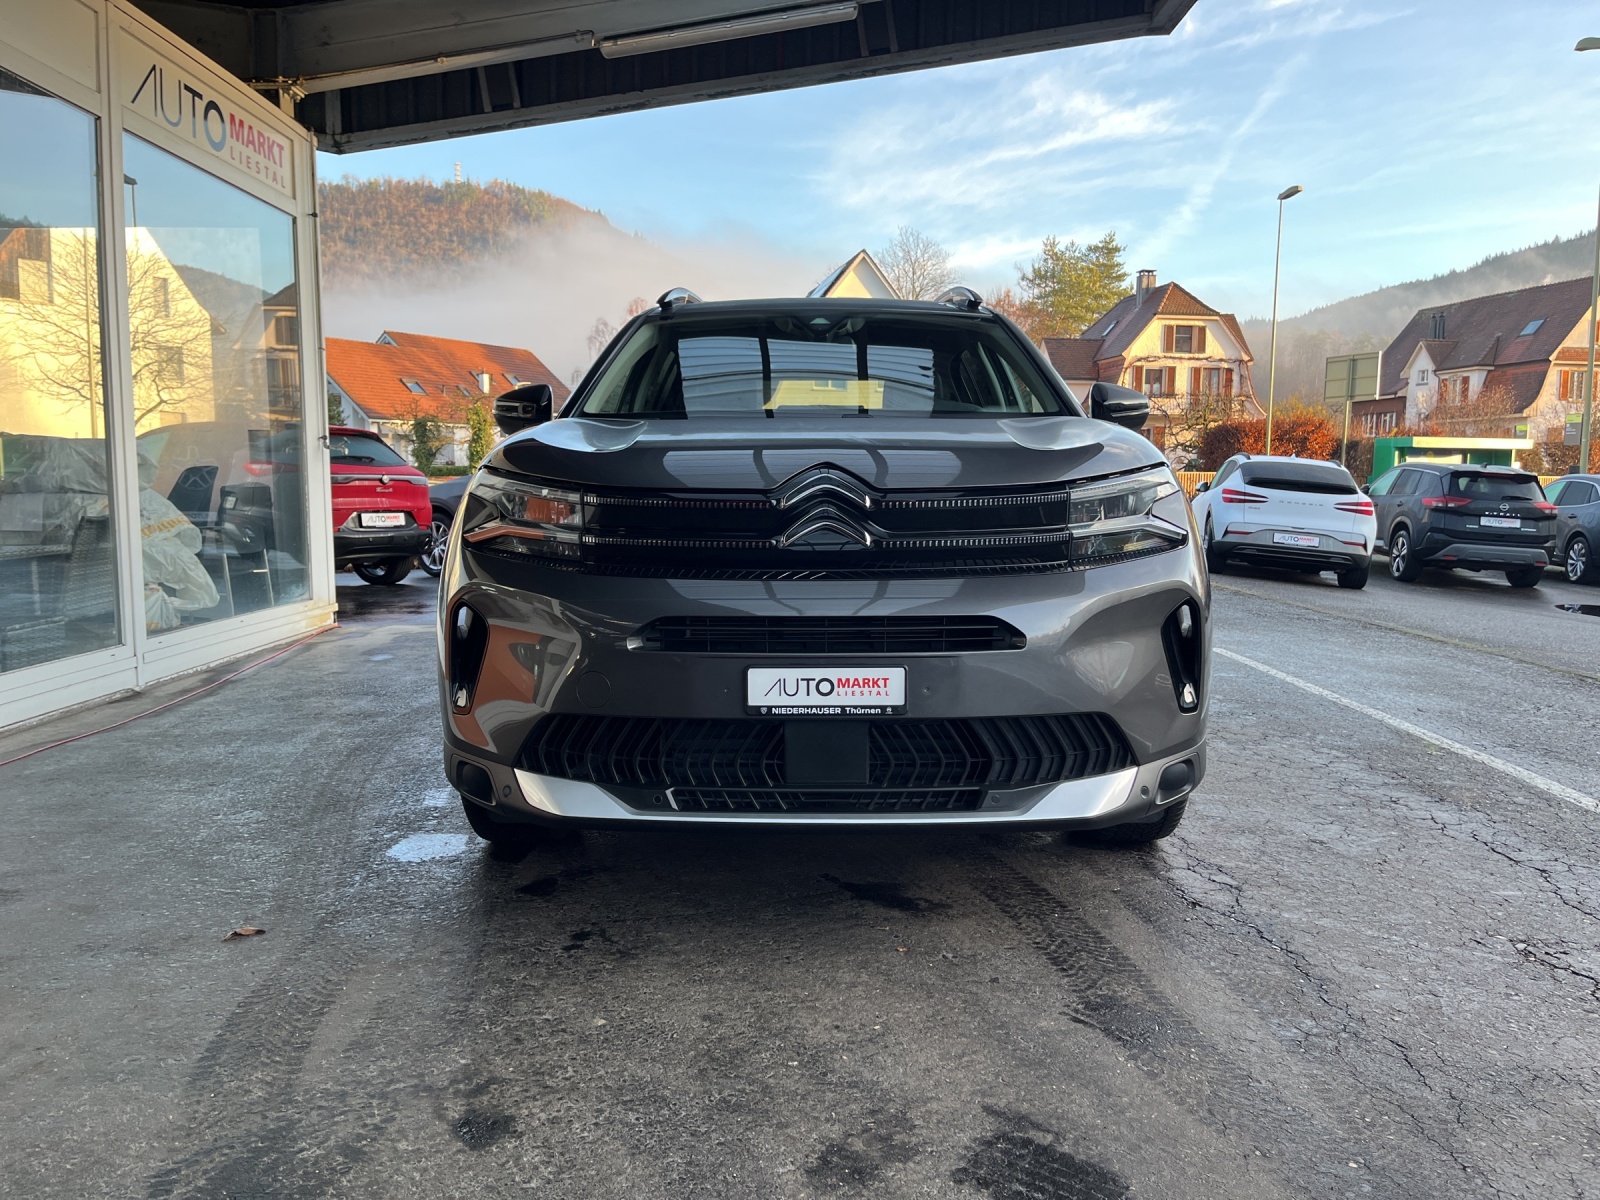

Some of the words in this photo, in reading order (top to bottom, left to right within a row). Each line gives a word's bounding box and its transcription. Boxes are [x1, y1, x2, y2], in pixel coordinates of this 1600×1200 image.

[131, 64, 227, 152] AUTO
[230, 112, 285, 168] MARKT
[230, 146, 286, 189] LIESTAL
[366, 515, 386, 523] AUTO
[764, 677, 835, 697] AUTO
[837, 677, 890, 688] MARKT
